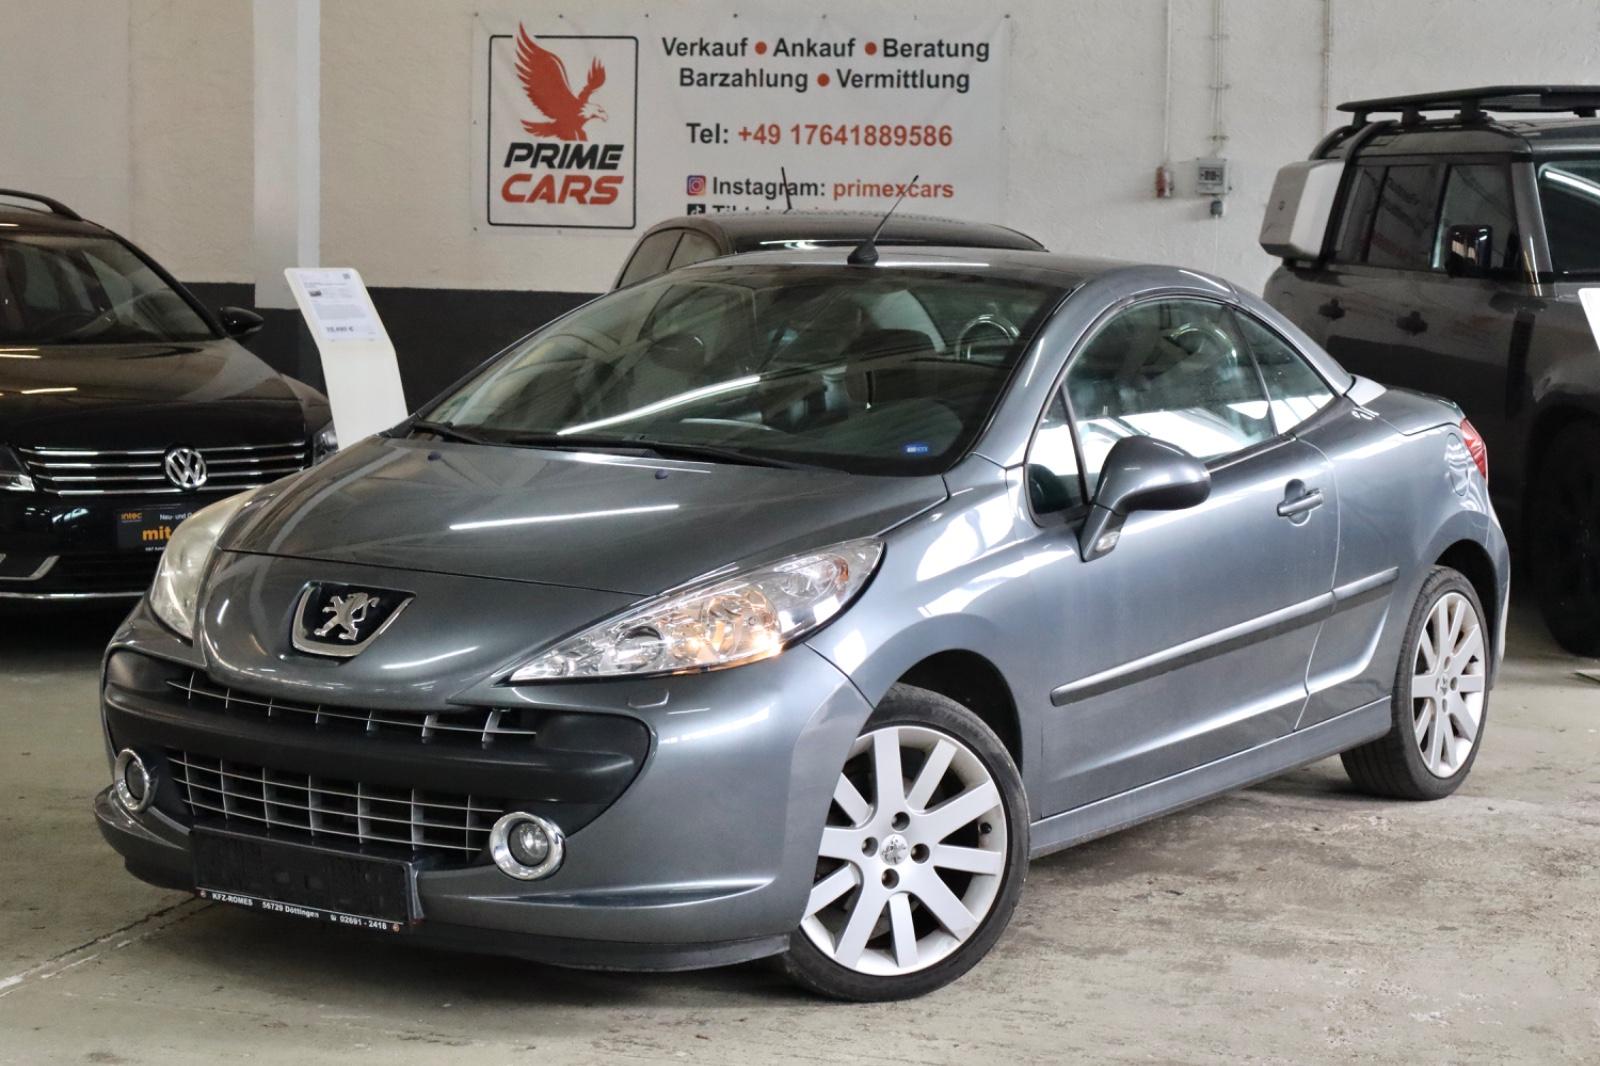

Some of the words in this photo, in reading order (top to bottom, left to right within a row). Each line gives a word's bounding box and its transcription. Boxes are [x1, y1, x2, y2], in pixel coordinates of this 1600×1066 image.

[662, 37, 749, 58] Verkauf
[773, 38, 857, 58] Ankauf
[882, 38, 990, 62] Beratung
[679, 68, 809, 93] Barzahlung
[836, 69, 970, 94] Vermittlung
[686, 123, 729, 145] Tel:
[738, 124, 781, 145] +49
[790, 124, 953, 147] 17641889586
[503, 143, 624, 170] PRIME
[501, 174, 624, 205] CARS
[713, 176, 825, 200] Instagram:
[833, 178, 954, 201] primexcars
[212, 892, 253, 906] KFZ-ROMES
